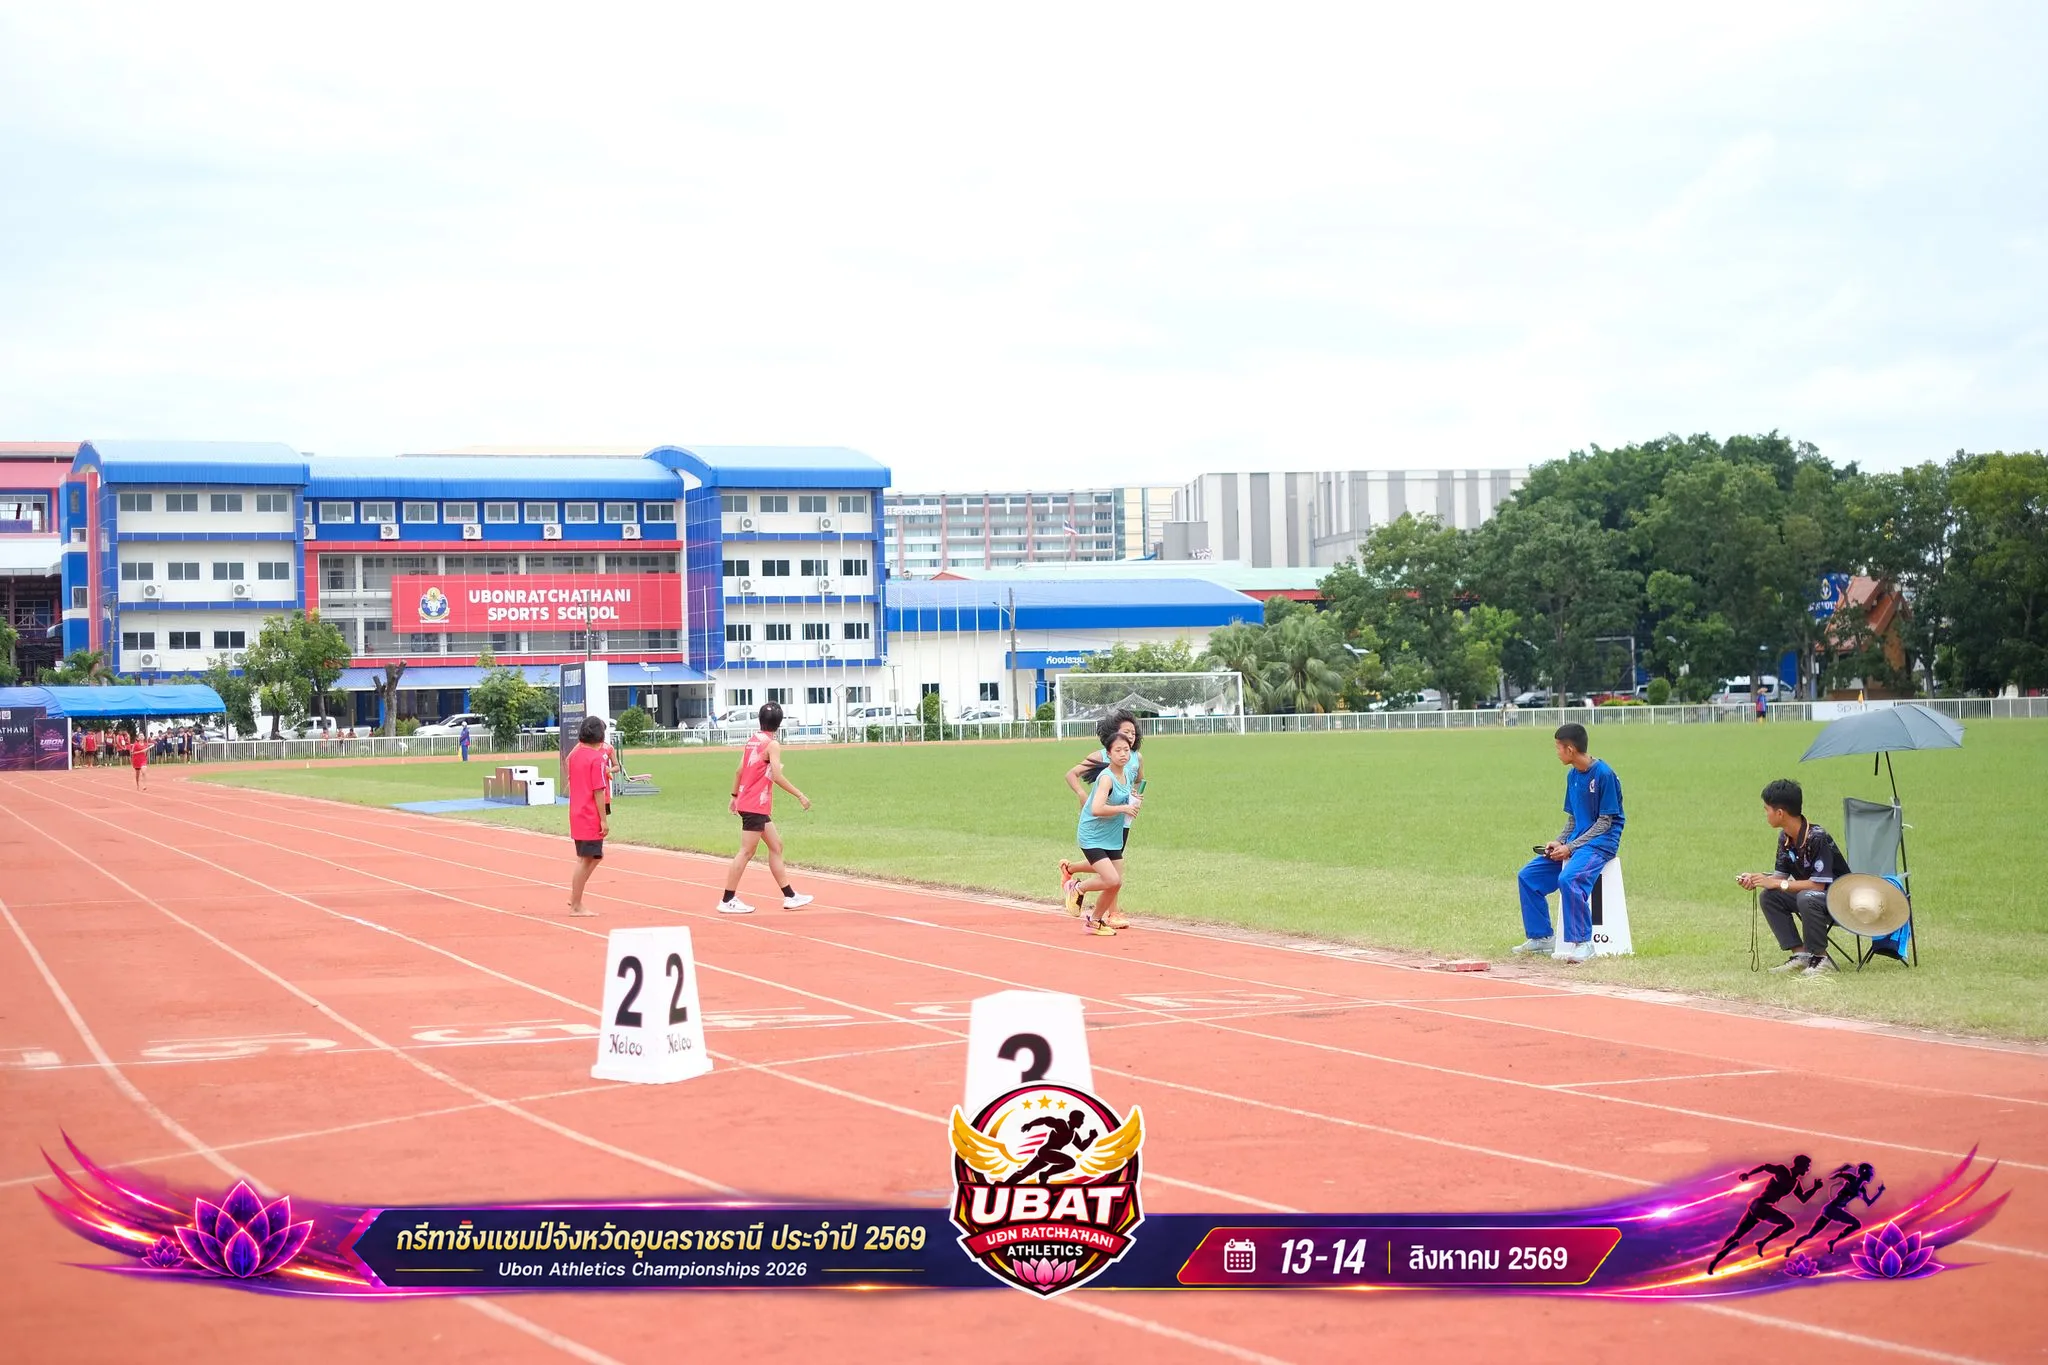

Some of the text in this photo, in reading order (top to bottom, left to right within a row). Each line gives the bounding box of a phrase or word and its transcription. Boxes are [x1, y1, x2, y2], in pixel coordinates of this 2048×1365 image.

[468, 588, 631, 604] UBONRATCHATHANI
[488, 605, 619, 621] SPORTS SCHOOL
[615, 955, 643, 1028] 2
[665, 952, 688, 1026] 2
[609, 1033, 643, 1057] Nelco
[666, 1032, 692, 1055] Nelco
